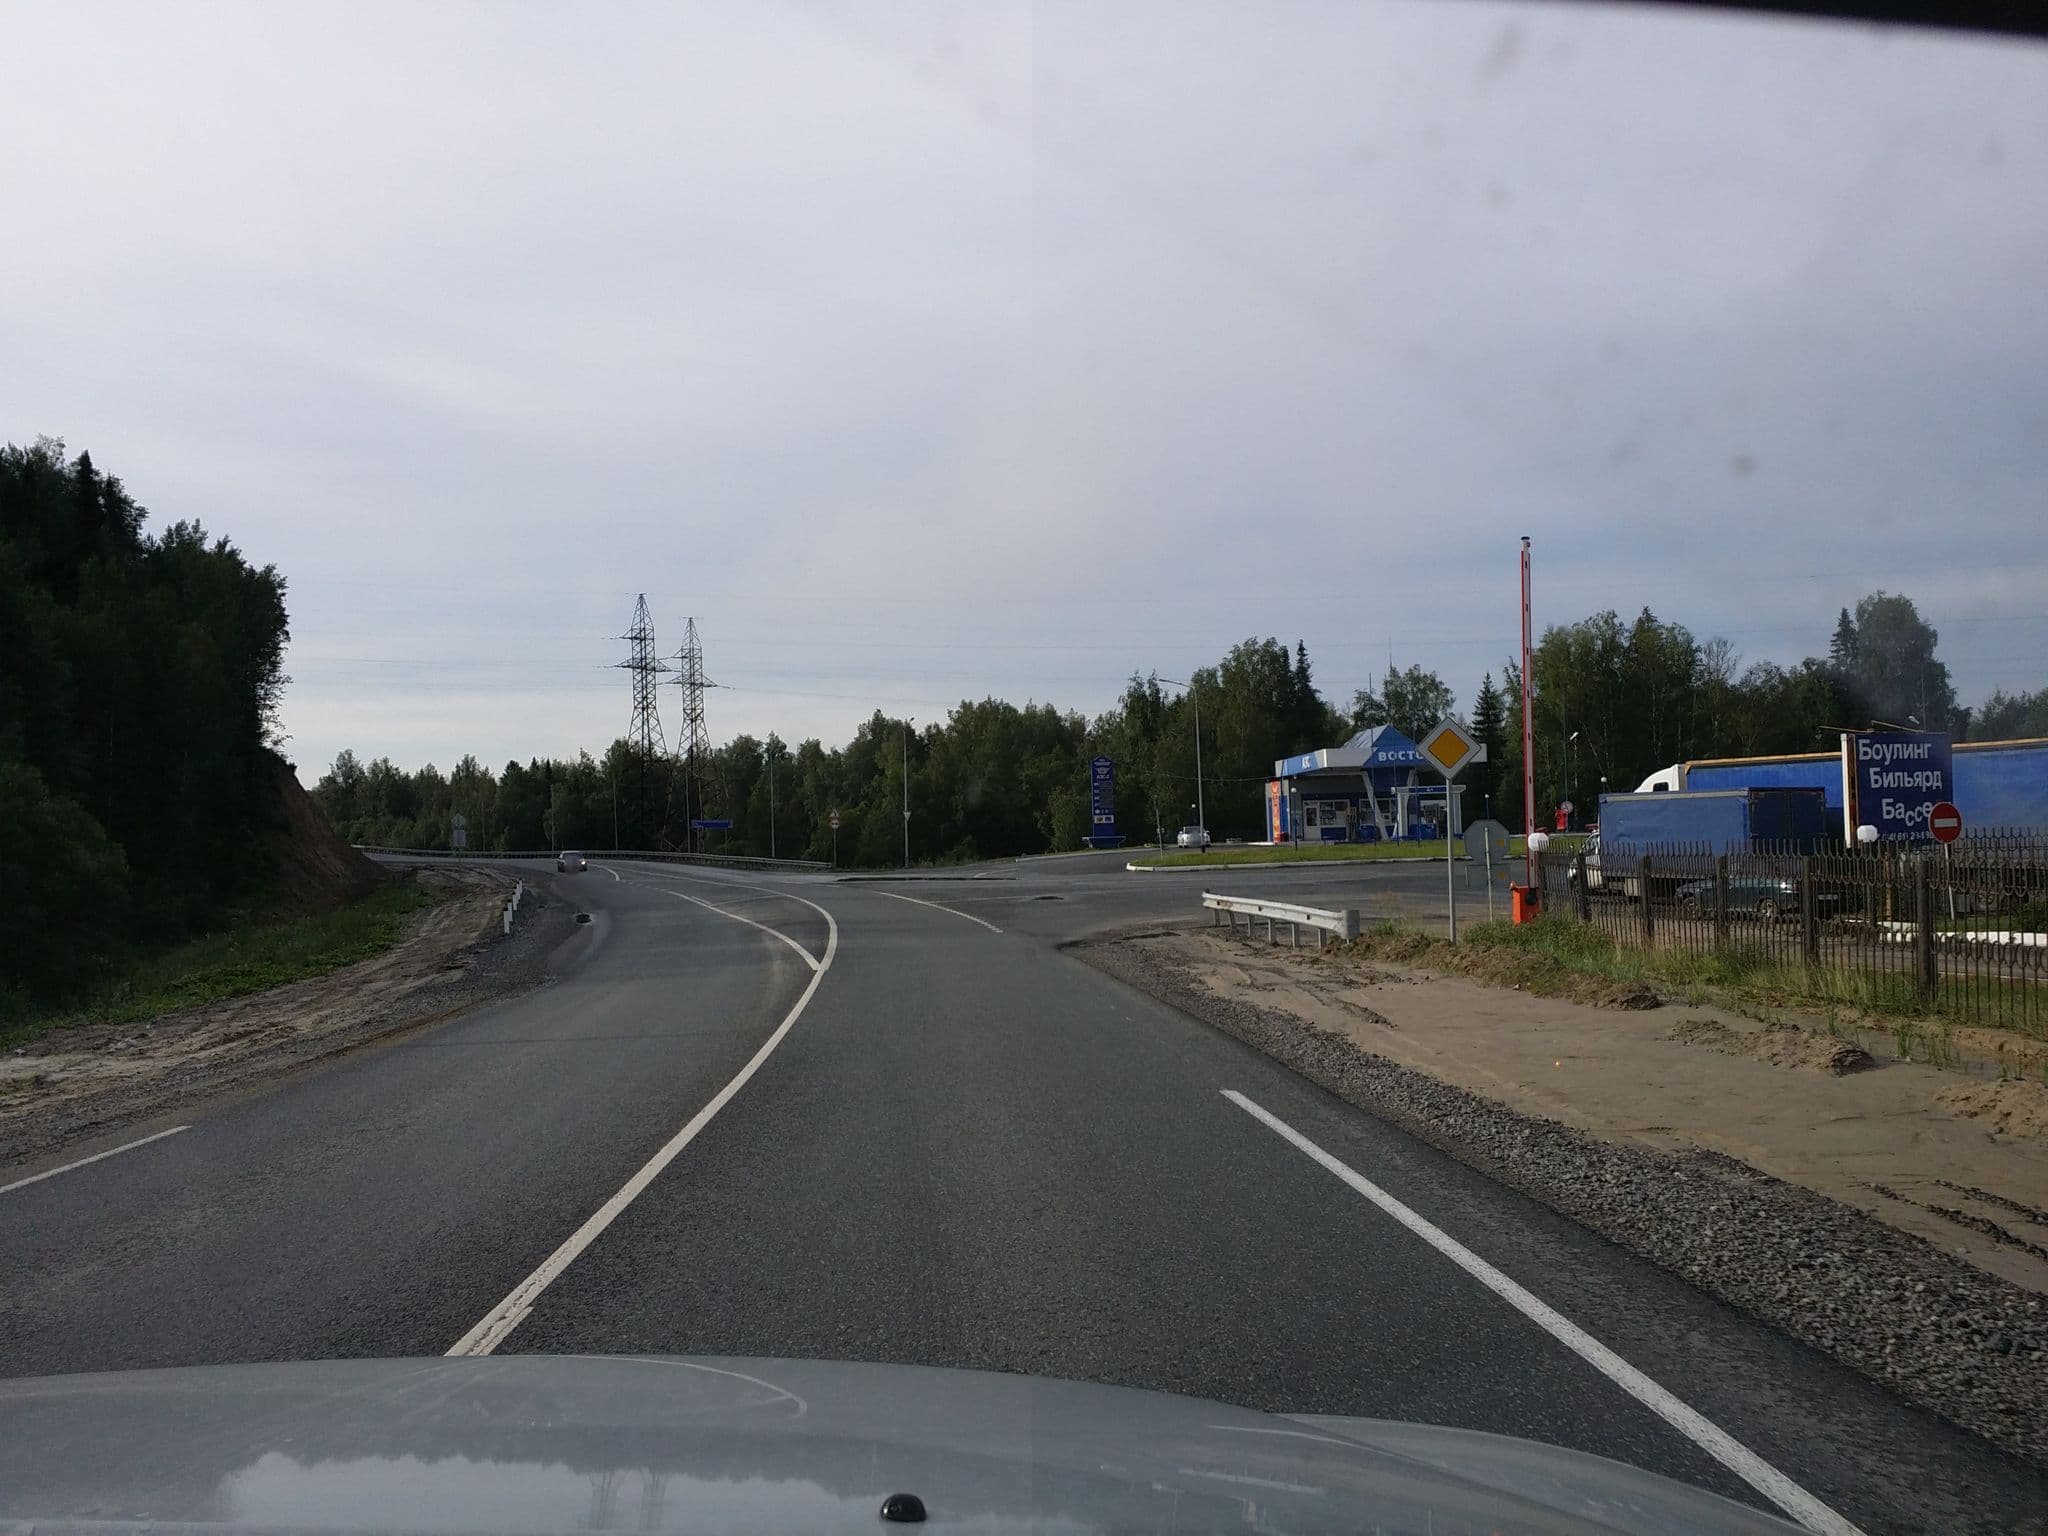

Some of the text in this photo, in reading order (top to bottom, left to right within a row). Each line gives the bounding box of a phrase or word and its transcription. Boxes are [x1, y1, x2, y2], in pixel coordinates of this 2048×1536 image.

[1378, 750, 1425, 761] ВОСТО
[1859, 739, 1932, 765] Боулинг
[1869, 767, 1942, 792] Бильярд
[1882, 798, 1933, 826] Бассе
